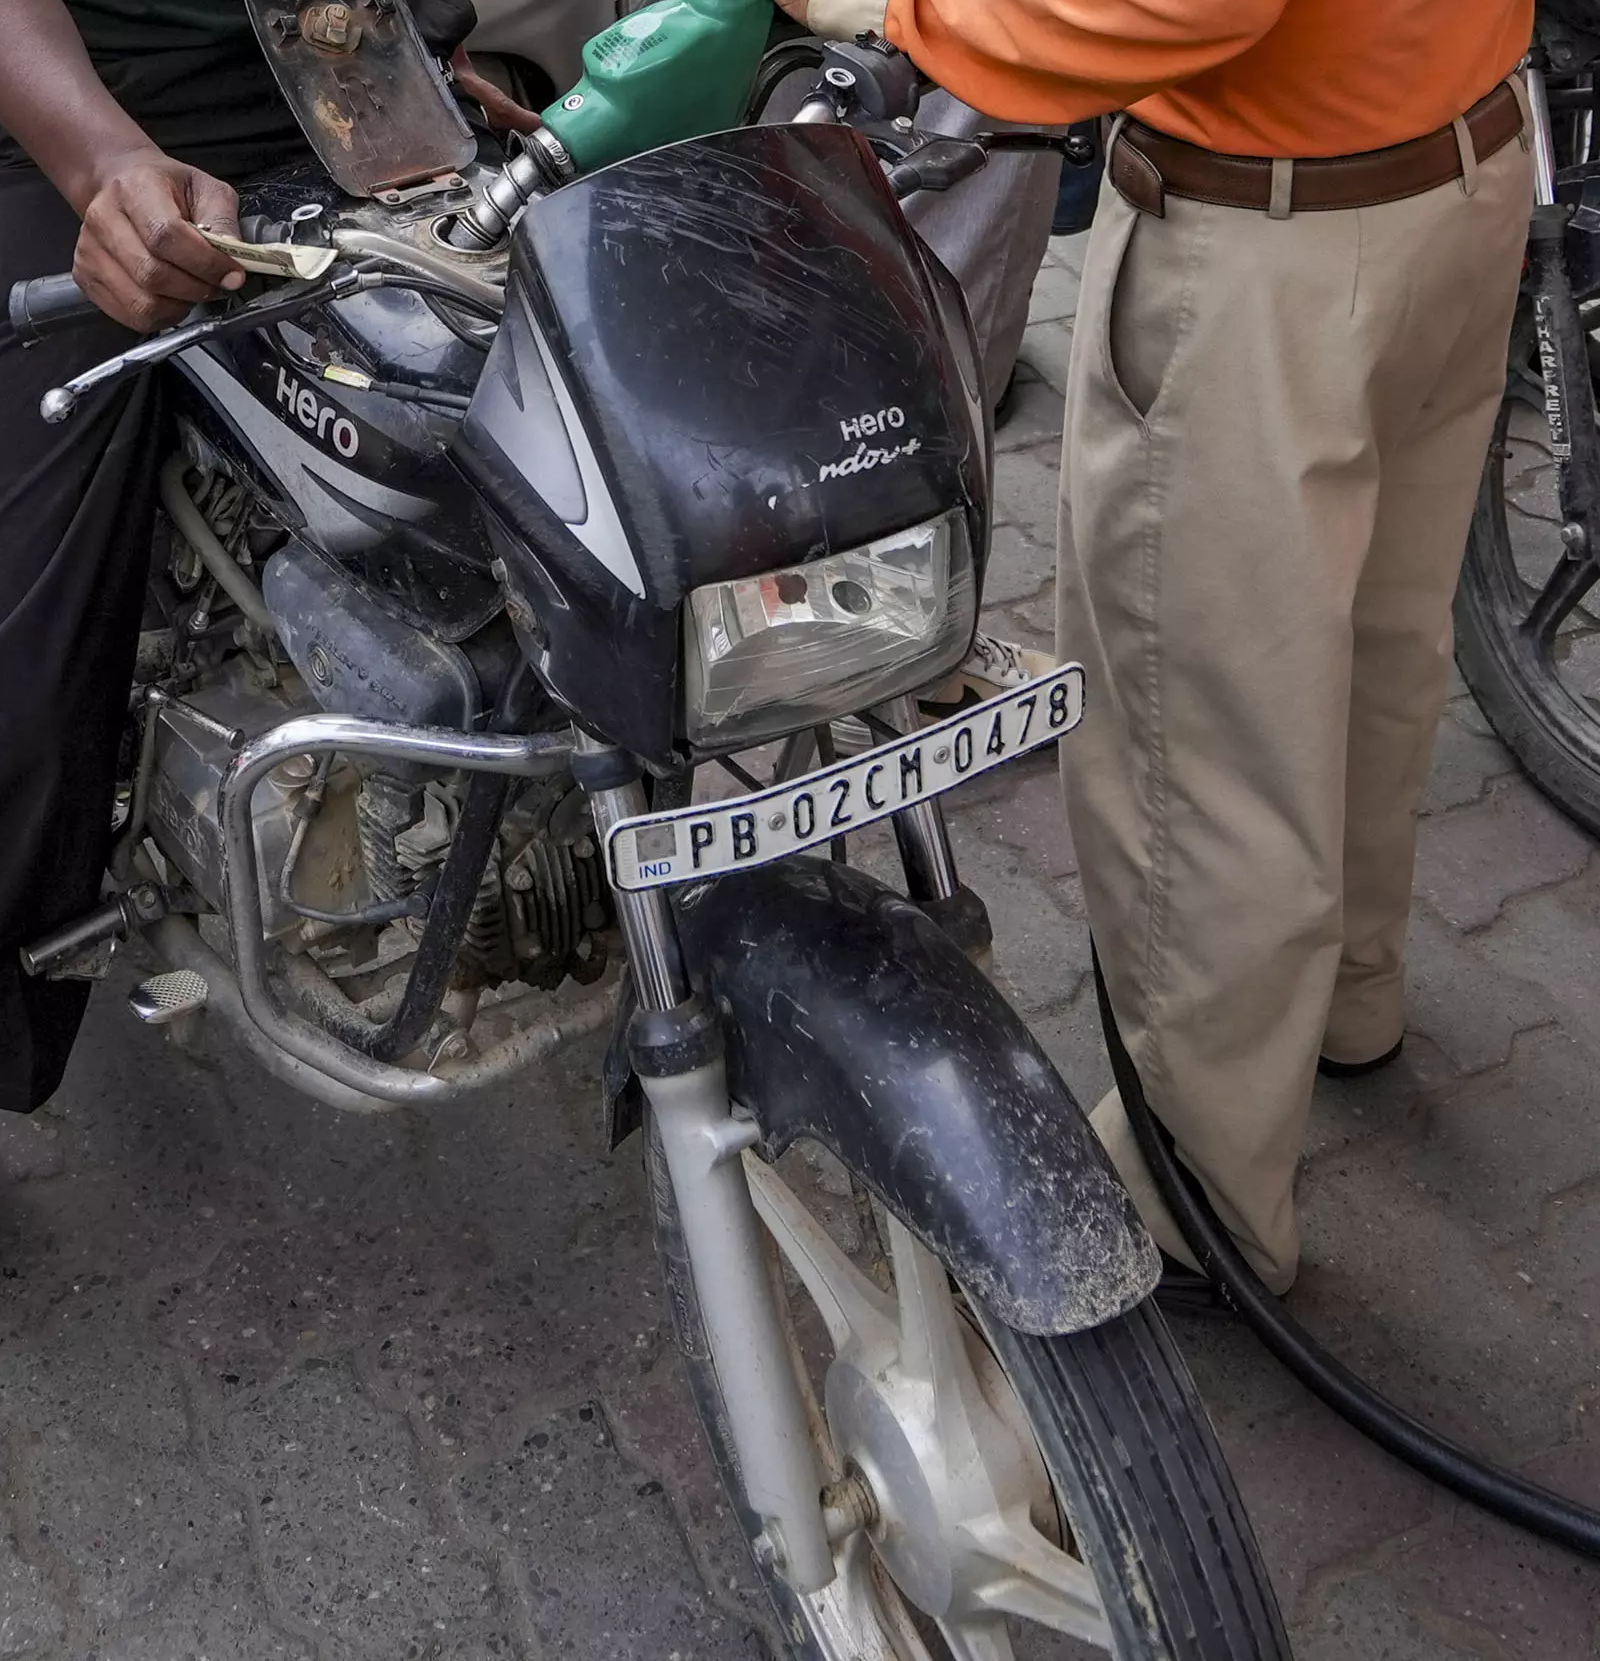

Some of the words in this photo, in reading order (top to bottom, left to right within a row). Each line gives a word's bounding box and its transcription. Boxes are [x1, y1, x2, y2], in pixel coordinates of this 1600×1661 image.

[276, 368, 360, 459] Hero
[840, 406, 905, 441] Hero
[639, 861, 672, 880] IND
